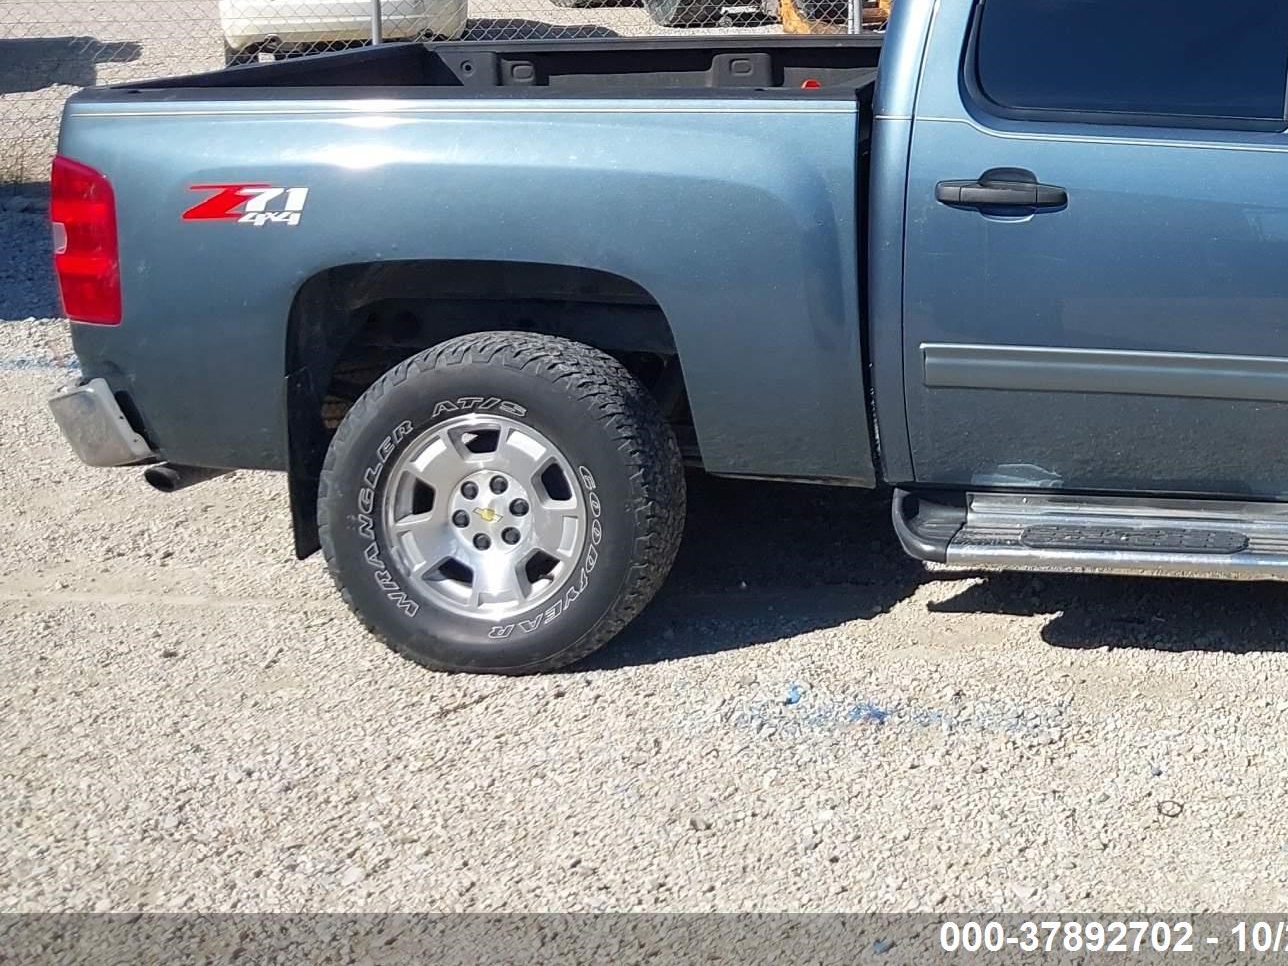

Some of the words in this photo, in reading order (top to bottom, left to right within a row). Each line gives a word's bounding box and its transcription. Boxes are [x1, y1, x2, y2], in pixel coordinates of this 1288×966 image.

[181, 182, 309, 222] Z71
[431, 397, 527, 418] AT/S
[358, 420, 420, 618] WRANGLER
[487, 465, 603, 639] GOODYEAR
